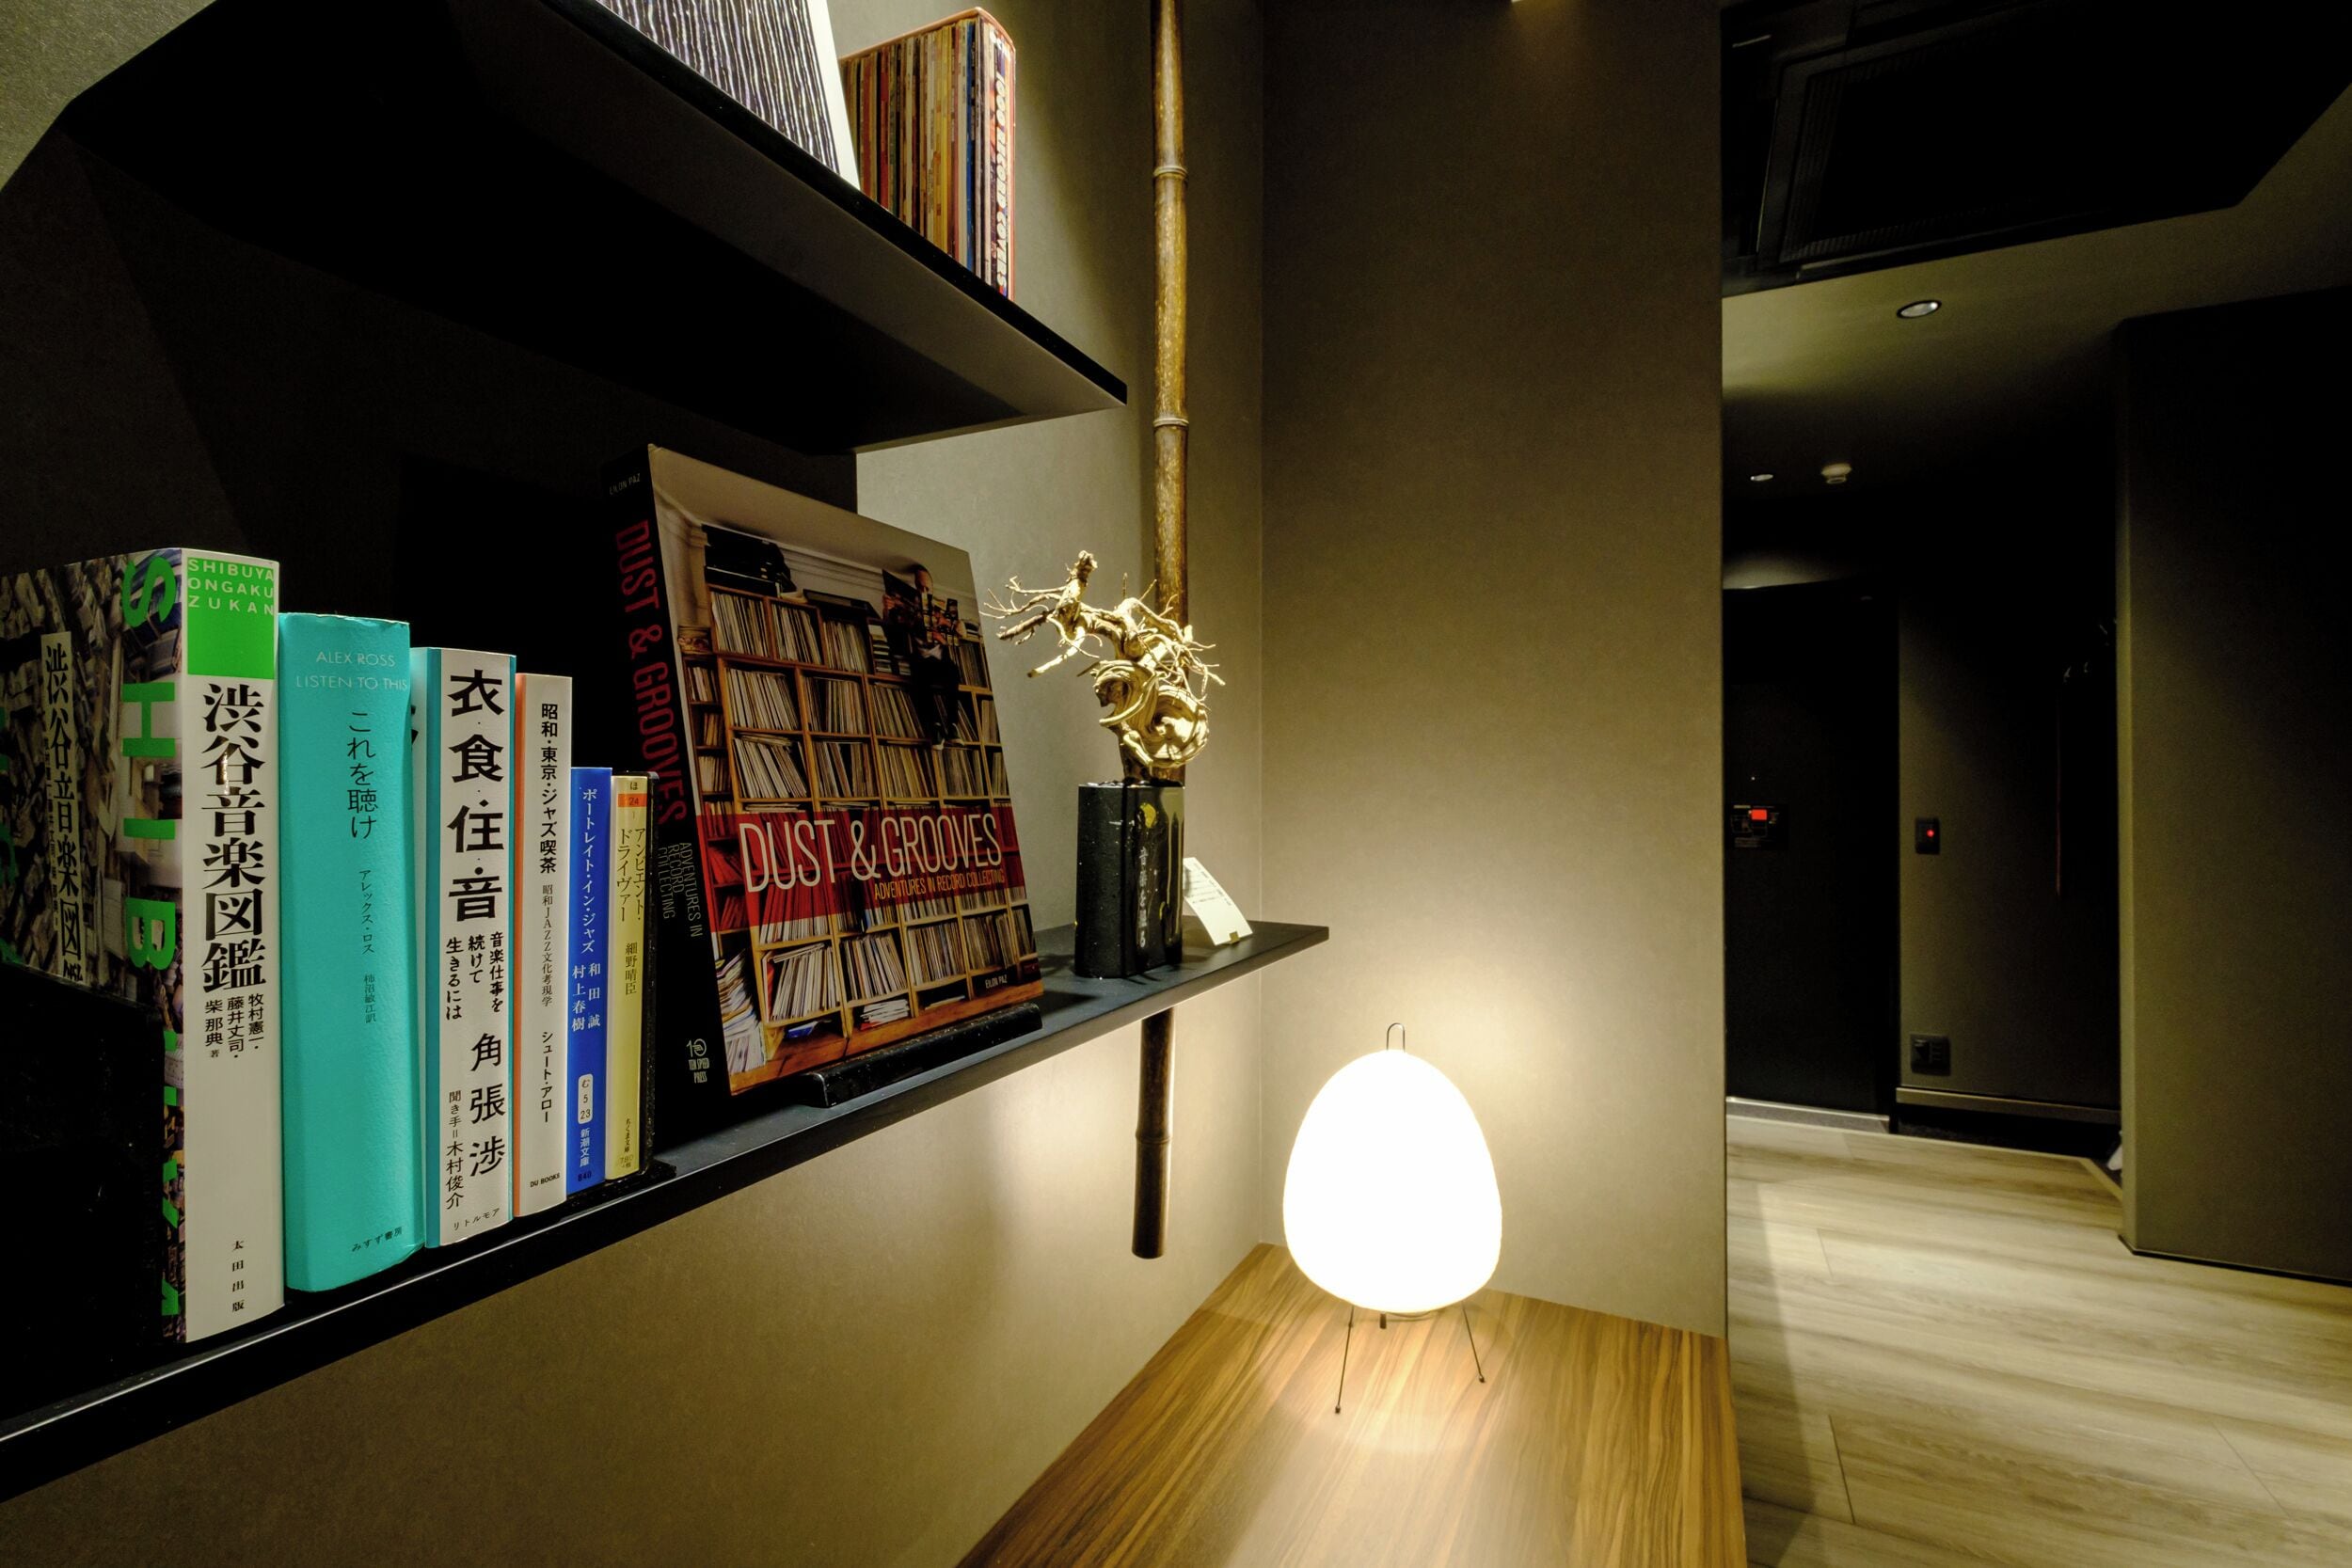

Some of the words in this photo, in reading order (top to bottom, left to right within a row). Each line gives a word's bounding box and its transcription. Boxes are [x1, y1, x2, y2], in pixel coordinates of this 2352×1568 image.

[995, 71, 1007, 126] 1000
[995, 127, 1007, 210] RECORD
[995, 212, 1007, 288] COVERS
[187, 558, 274, 582] SHIBUYA
[187, 577, 274, 599] ONGAKU
[616, 519, 660, 612] DUST
[187, 594, 274, 616] ZUKAN
[316, 651, 352, 665] ALEX
[358, 652, 396, 667] ROSS
[628, 624, 663, 658] &
[296, 675, 354, 689] LISTEN
[358, 676, 378, 690] TO
[383, 678, 408, 691] THIS
[347, 711, 378, 839] これを聴け
[540, 703, 558, 874] 昭和・東京・ジャズ喫茶
[628, 797, 640, 806] 24
[629, 781, 639, 791] ほ
[201, 683, 265, 992] 渋谷音楽図鑑
[739, 819, 837, 893] DUST
[850, 819, 882, 880] &
[882, 813, 1003, 878] GROOVES
[580, 788, 597, 954] ポートレイト・イン・ジャズ
[616, 829, 631, 923] ドライヴァー
[658, 847, 677, 919] COLLECTING
[668, 844, 685, 894] RECORD
[678, 842, 703, 923] ADVENTURES
[874, 880, 926, 900] ADVENTURES
[927, 878, 935, 892] IN
[936, 874, 965, 890] RECORD
[966, 869, 1006, 887] COLLECTING
[359, 869, 376, 954] アレックス・ロス
[688, 924, 704, 938] IN
[445, 937, 464, 1021] 生きるには
[469, 934, 486, 984] 続けて
[489, 931, 504, 1013] 音楽仕事を
[625, 942, 638, 995] 細野晴臣
[572, 965, 586, 1032] 村上春樹
[541, 1031, 553, 1123] シュート・アロー
[469, 1033, 506, 1178] 角張渉
[580, 1110, 591, 1119] 23
[580, 1128, 591, 1168] 新潮文庫
[530, 1180, 539, 1188] DU
[540, 1172, 561, 1184] BOOKS
[352, 1226, 404, 1253] みすず書房
[453, 1207, 501, 1231] リトルモア
[231, 1240, 245, 1313] 太田出版
